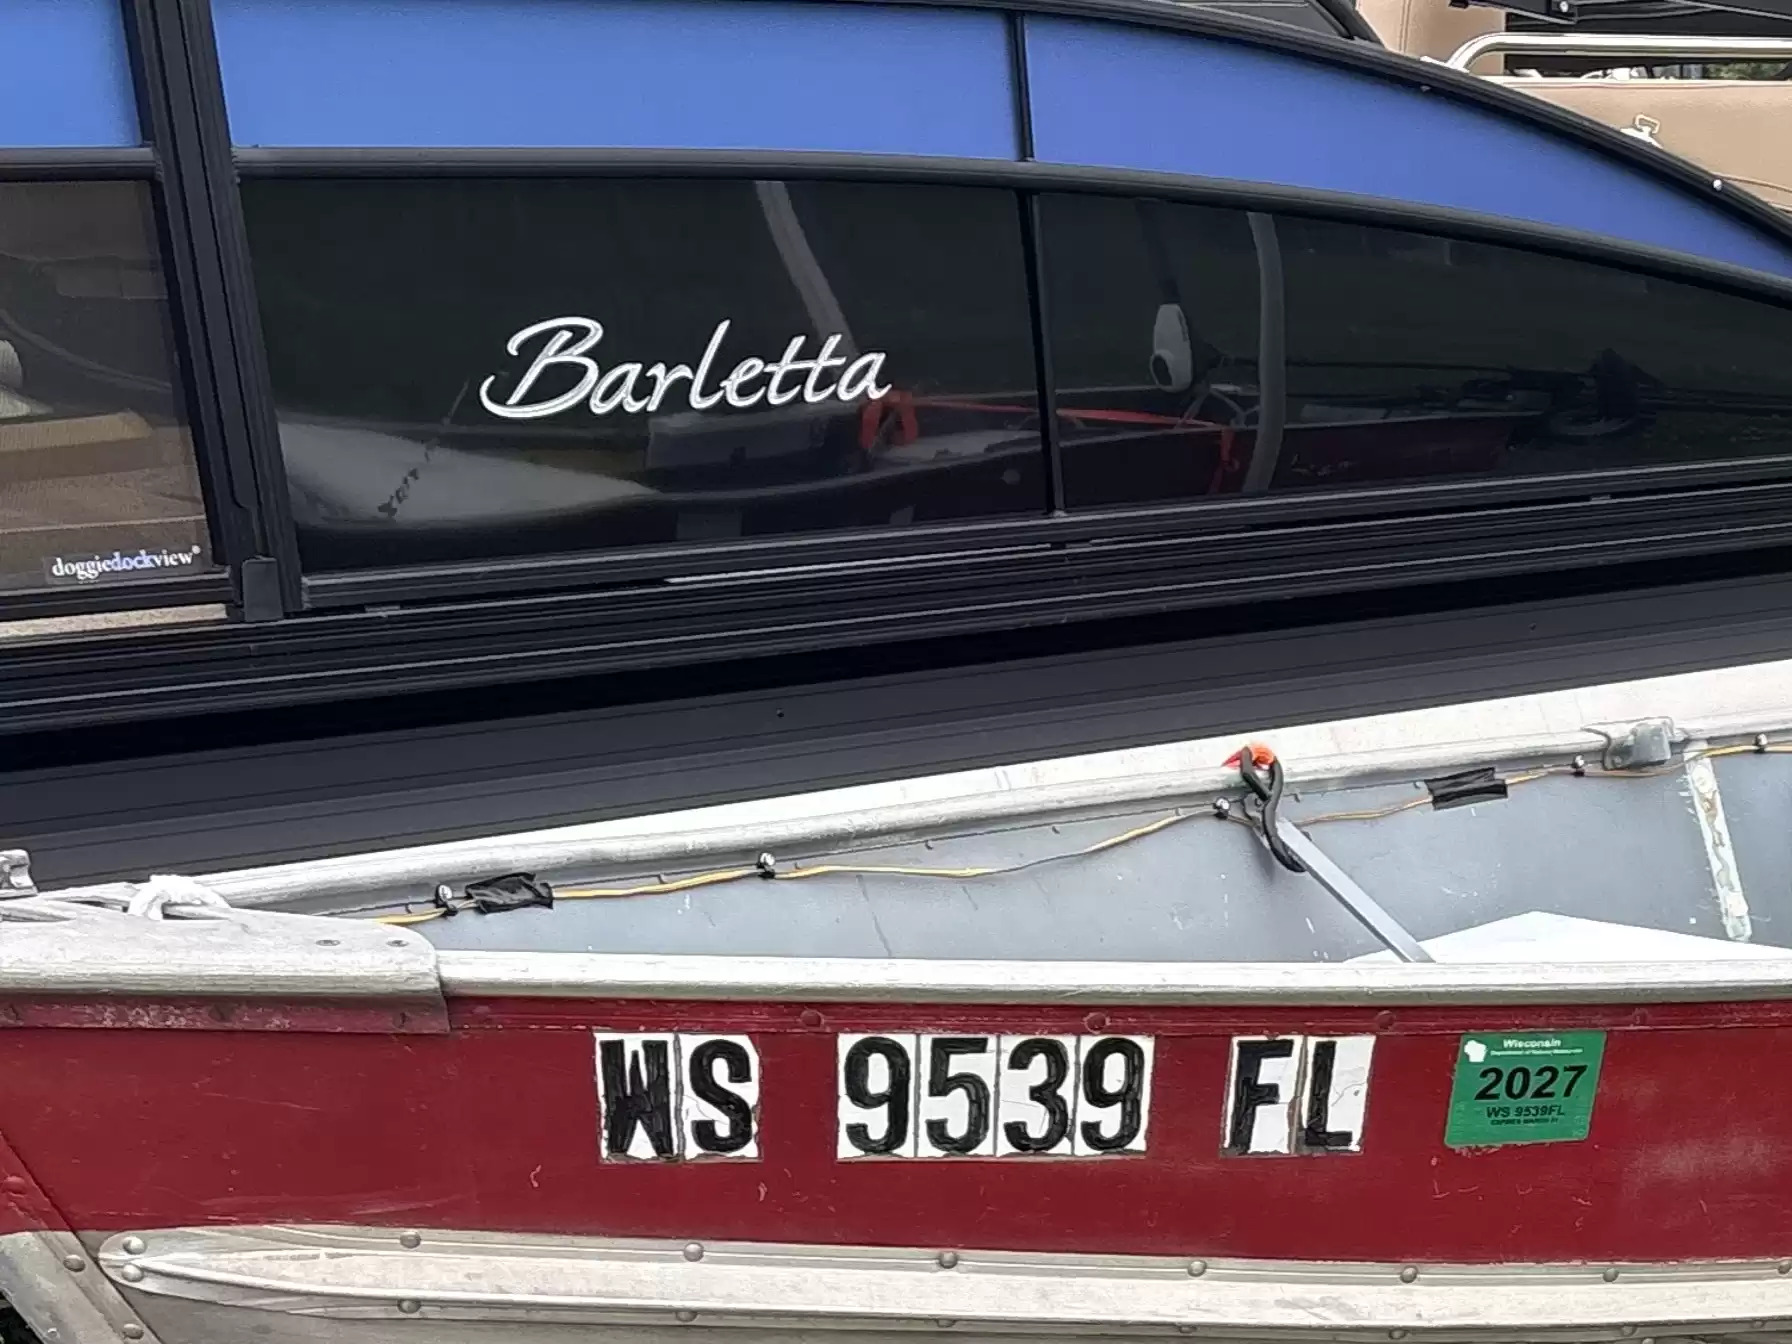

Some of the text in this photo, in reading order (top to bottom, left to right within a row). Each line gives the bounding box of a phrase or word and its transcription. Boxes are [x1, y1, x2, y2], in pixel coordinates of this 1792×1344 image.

[480, 316, 893, 418] Barletta
[1503, 1038, 1562, 1048] Wisconsin
[601, 1037, 1354, 1155] WS 9539 FL
[1474, 1064, 1588, 1100] 2027
[1486, 1104, 1565, 1118] WS 9539FL
